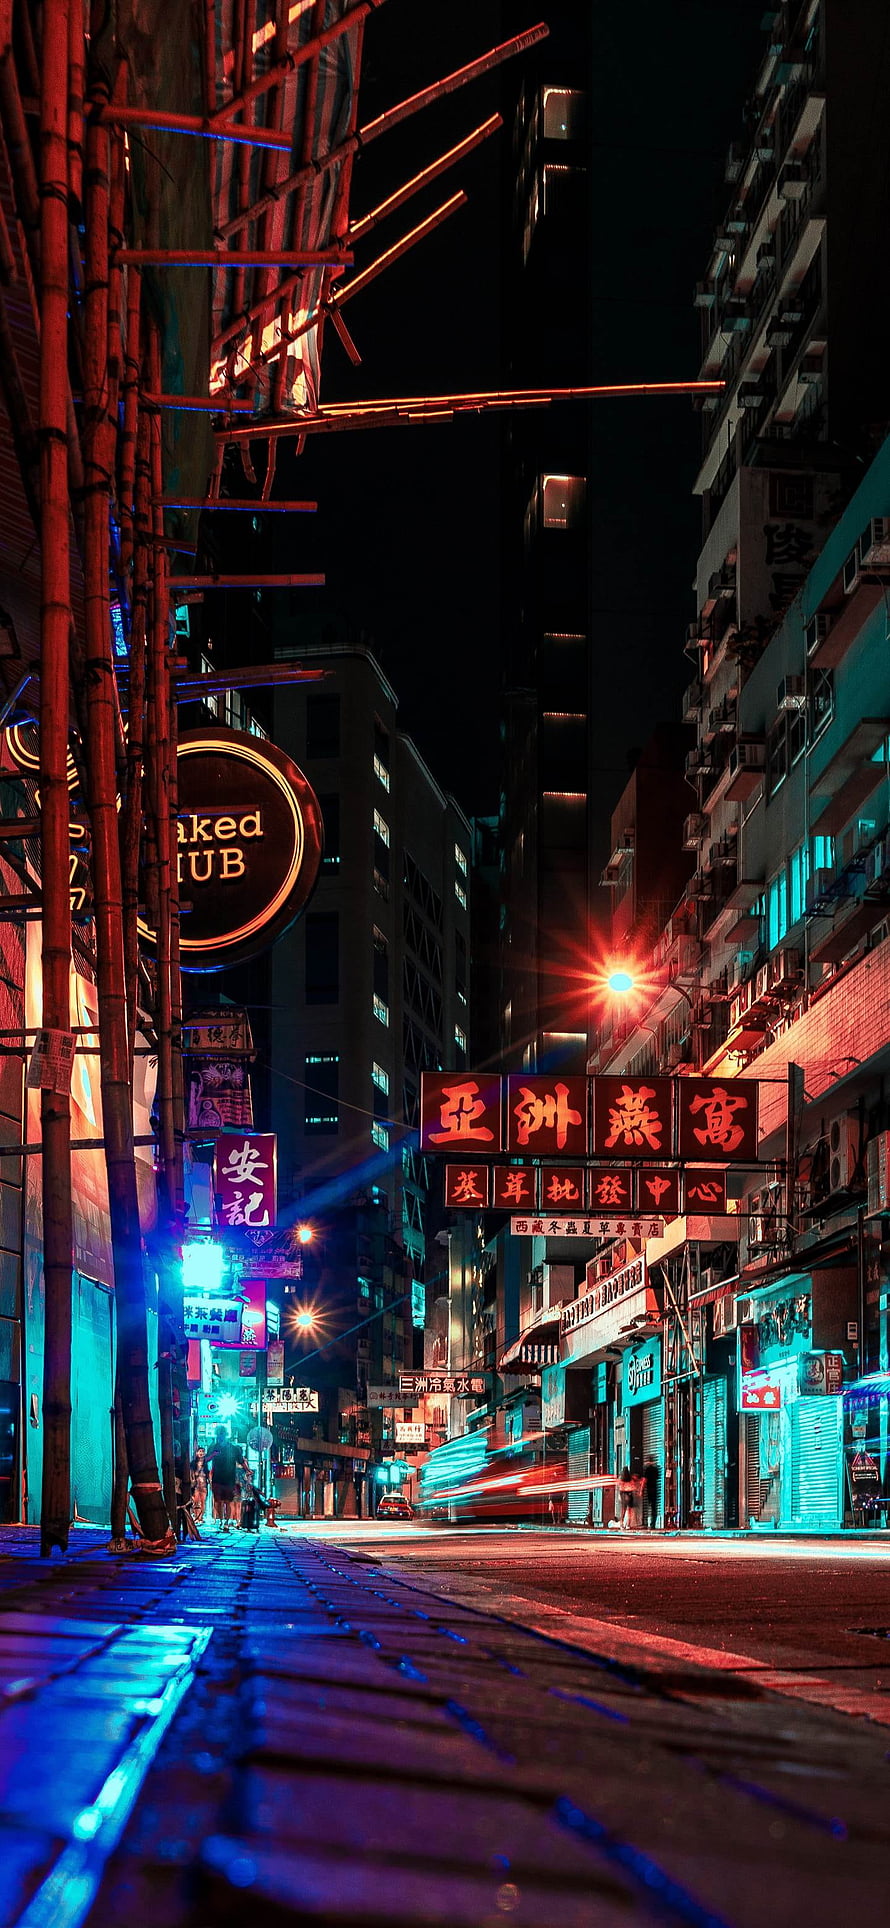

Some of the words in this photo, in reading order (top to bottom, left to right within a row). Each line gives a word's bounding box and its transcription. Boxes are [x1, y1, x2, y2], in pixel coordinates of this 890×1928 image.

[177, 810, 264, 843] aked
[428, 1081, 748, 1152] 亞洲燕窩
[221, 1140, 269, 1226] 安記
[401, 1377, 484, 1393] 三洲冷氣水電
